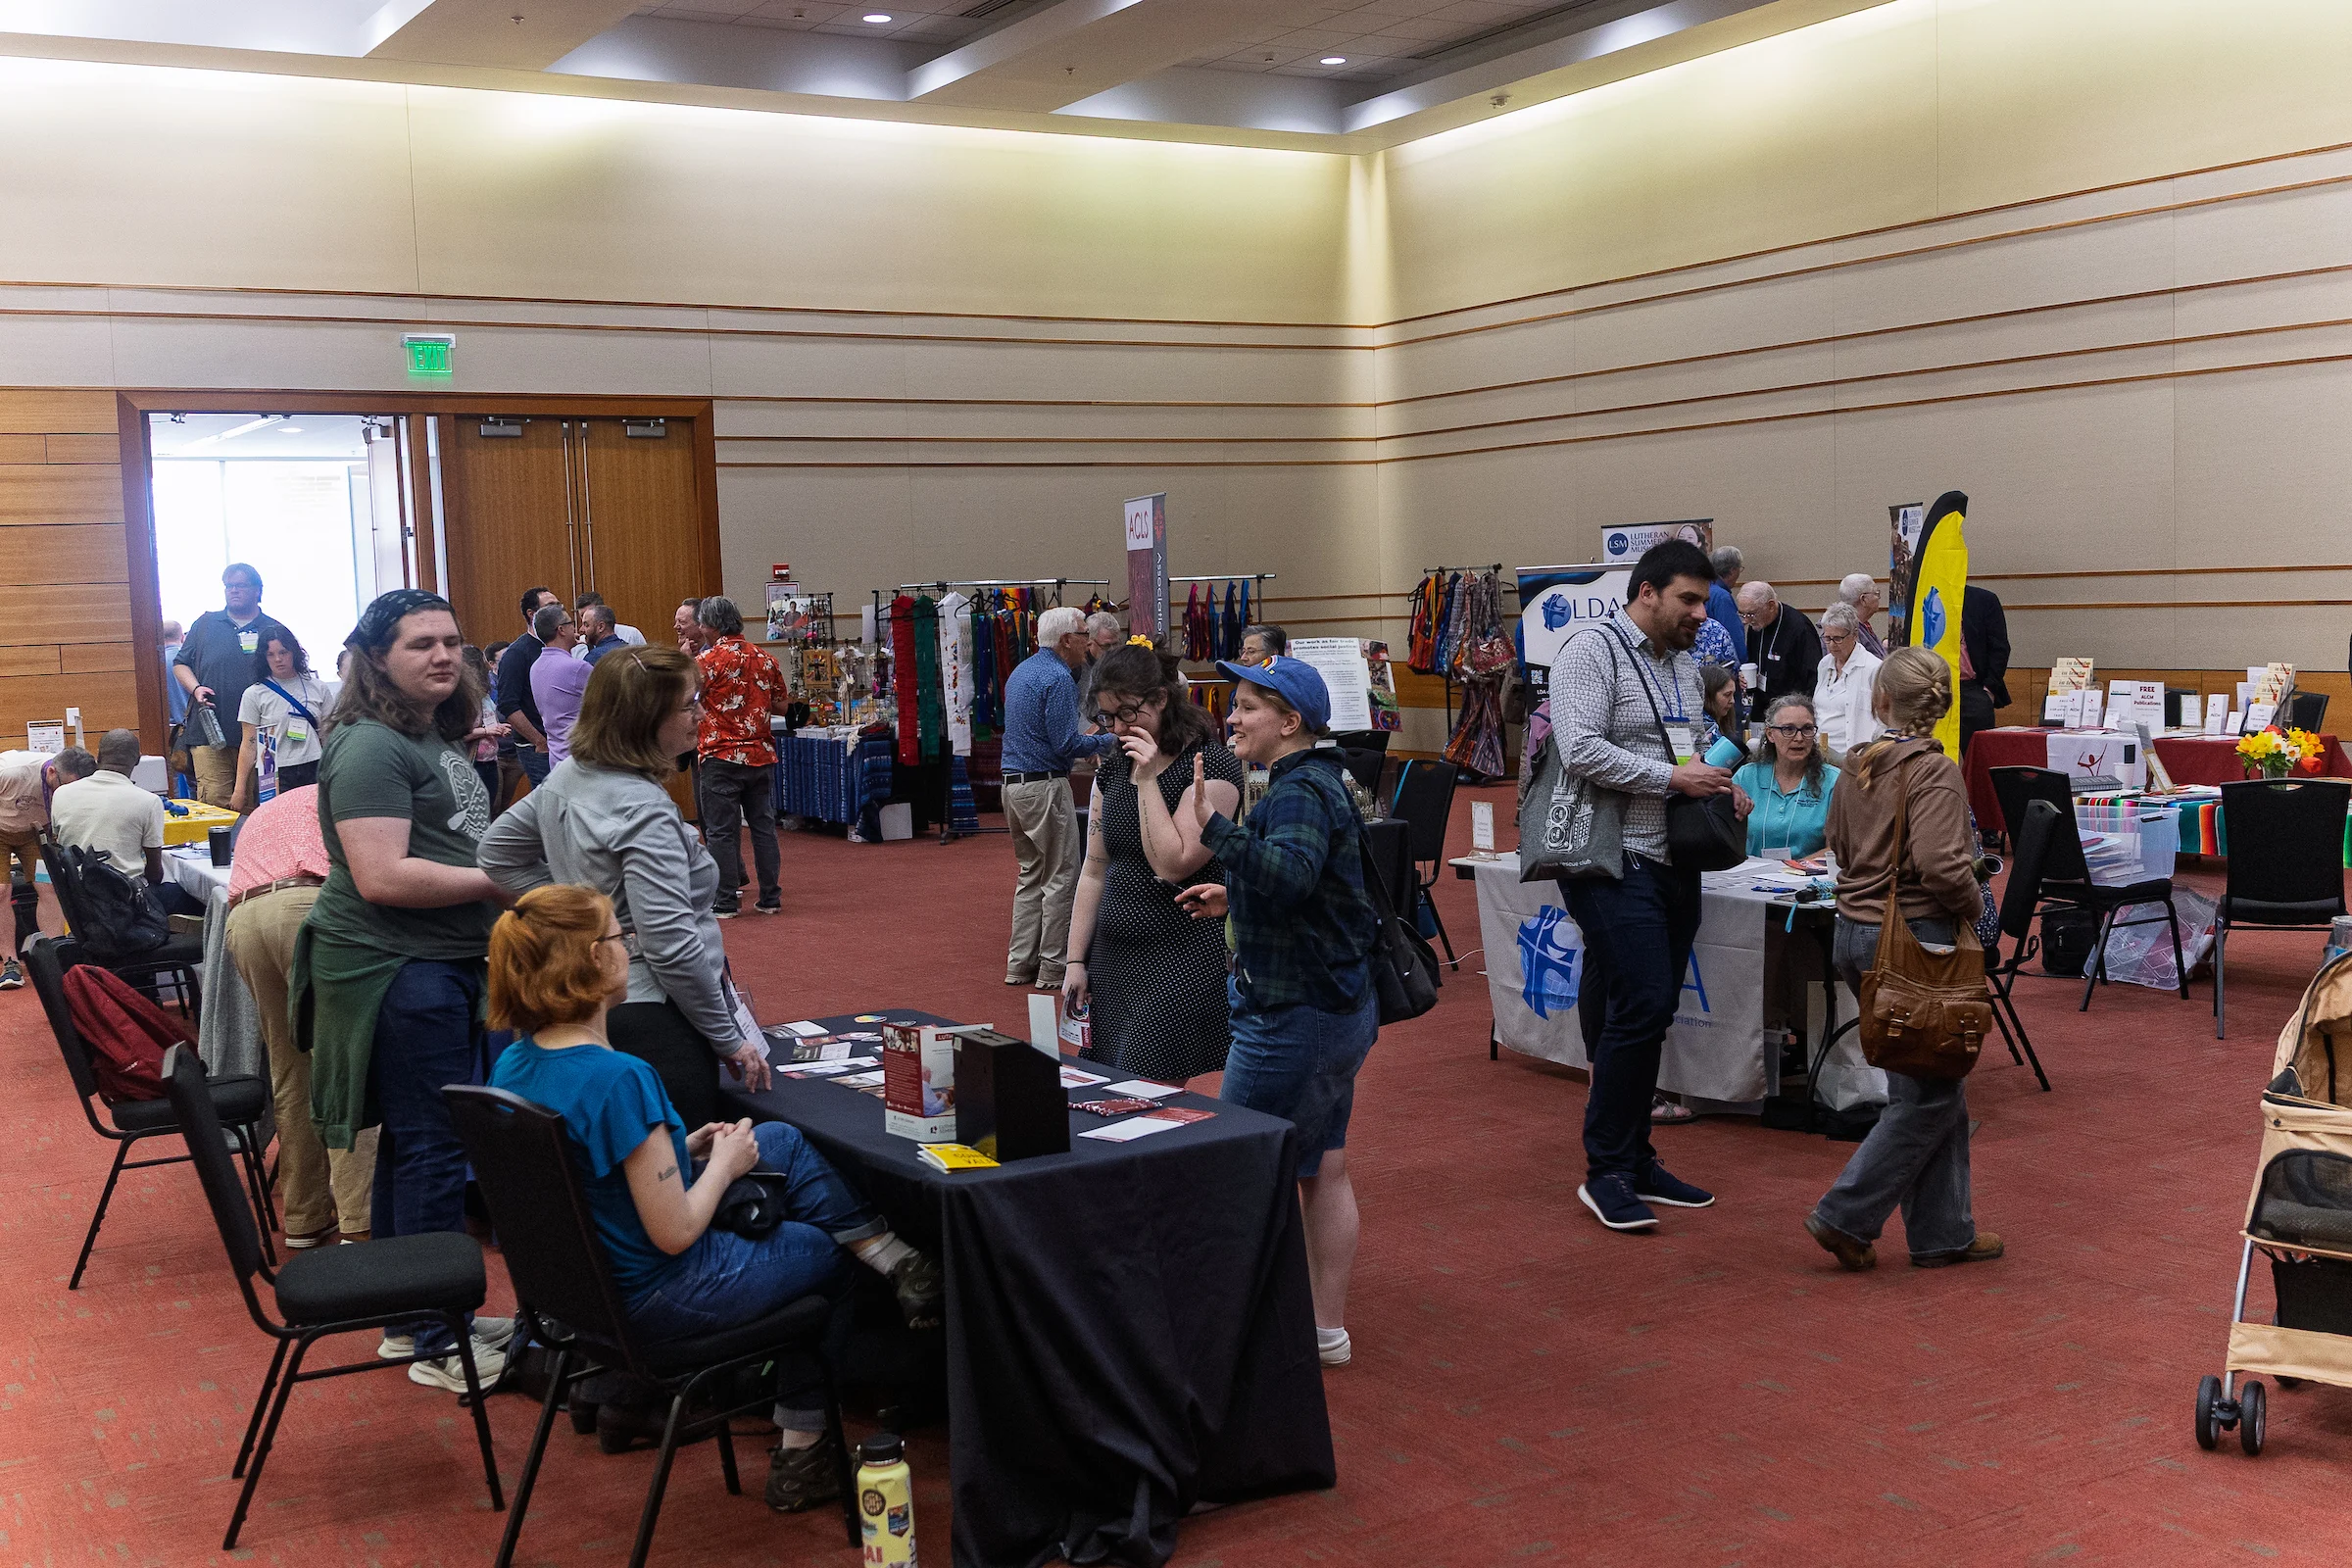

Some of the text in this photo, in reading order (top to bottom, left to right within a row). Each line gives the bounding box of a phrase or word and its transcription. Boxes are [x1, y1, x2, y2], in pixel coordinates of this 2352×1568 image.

[415, 345, 447, 370] EXIT
[1608, 539, 1628, 549] LSM
[1630, 538, 1662, 547] SUMMER
[1573, 598, 1620, 618] LDA
